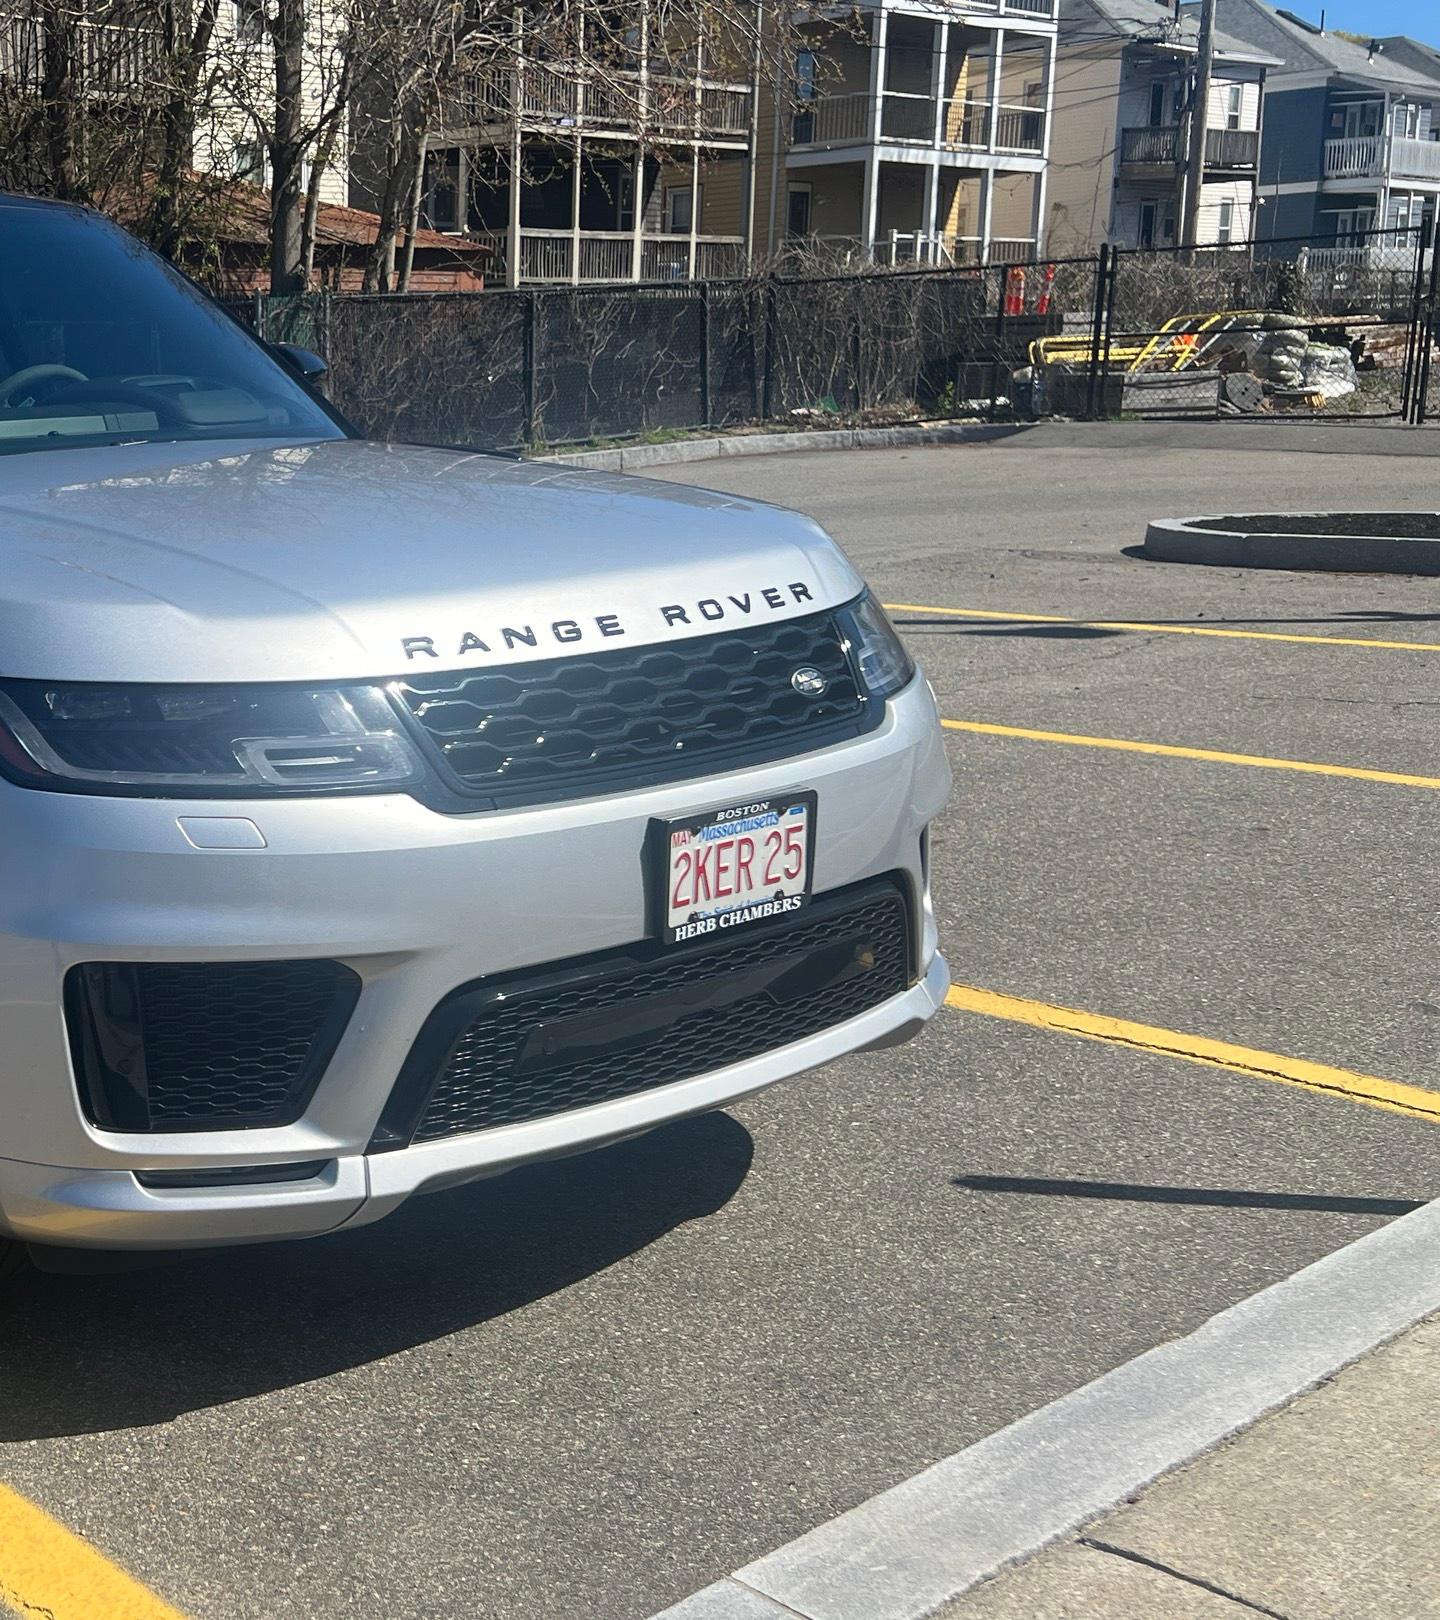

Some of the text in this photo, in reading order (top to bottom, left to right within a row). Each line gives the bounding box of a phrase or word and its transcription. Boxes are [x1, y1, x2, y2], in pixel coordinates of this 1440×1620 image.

[400, 581, 814, 660] RANGE ROVER
[698, 810, 779, 842] Massachusetts
[715, 801, 770, 822] BOSTON
[671, 830, 692, 848] MAY
[671, 824, 805, 909] 2KER 25
[675, 917, 718, 942] HERB
[719, 895, 802, 928] CHAMBERS
